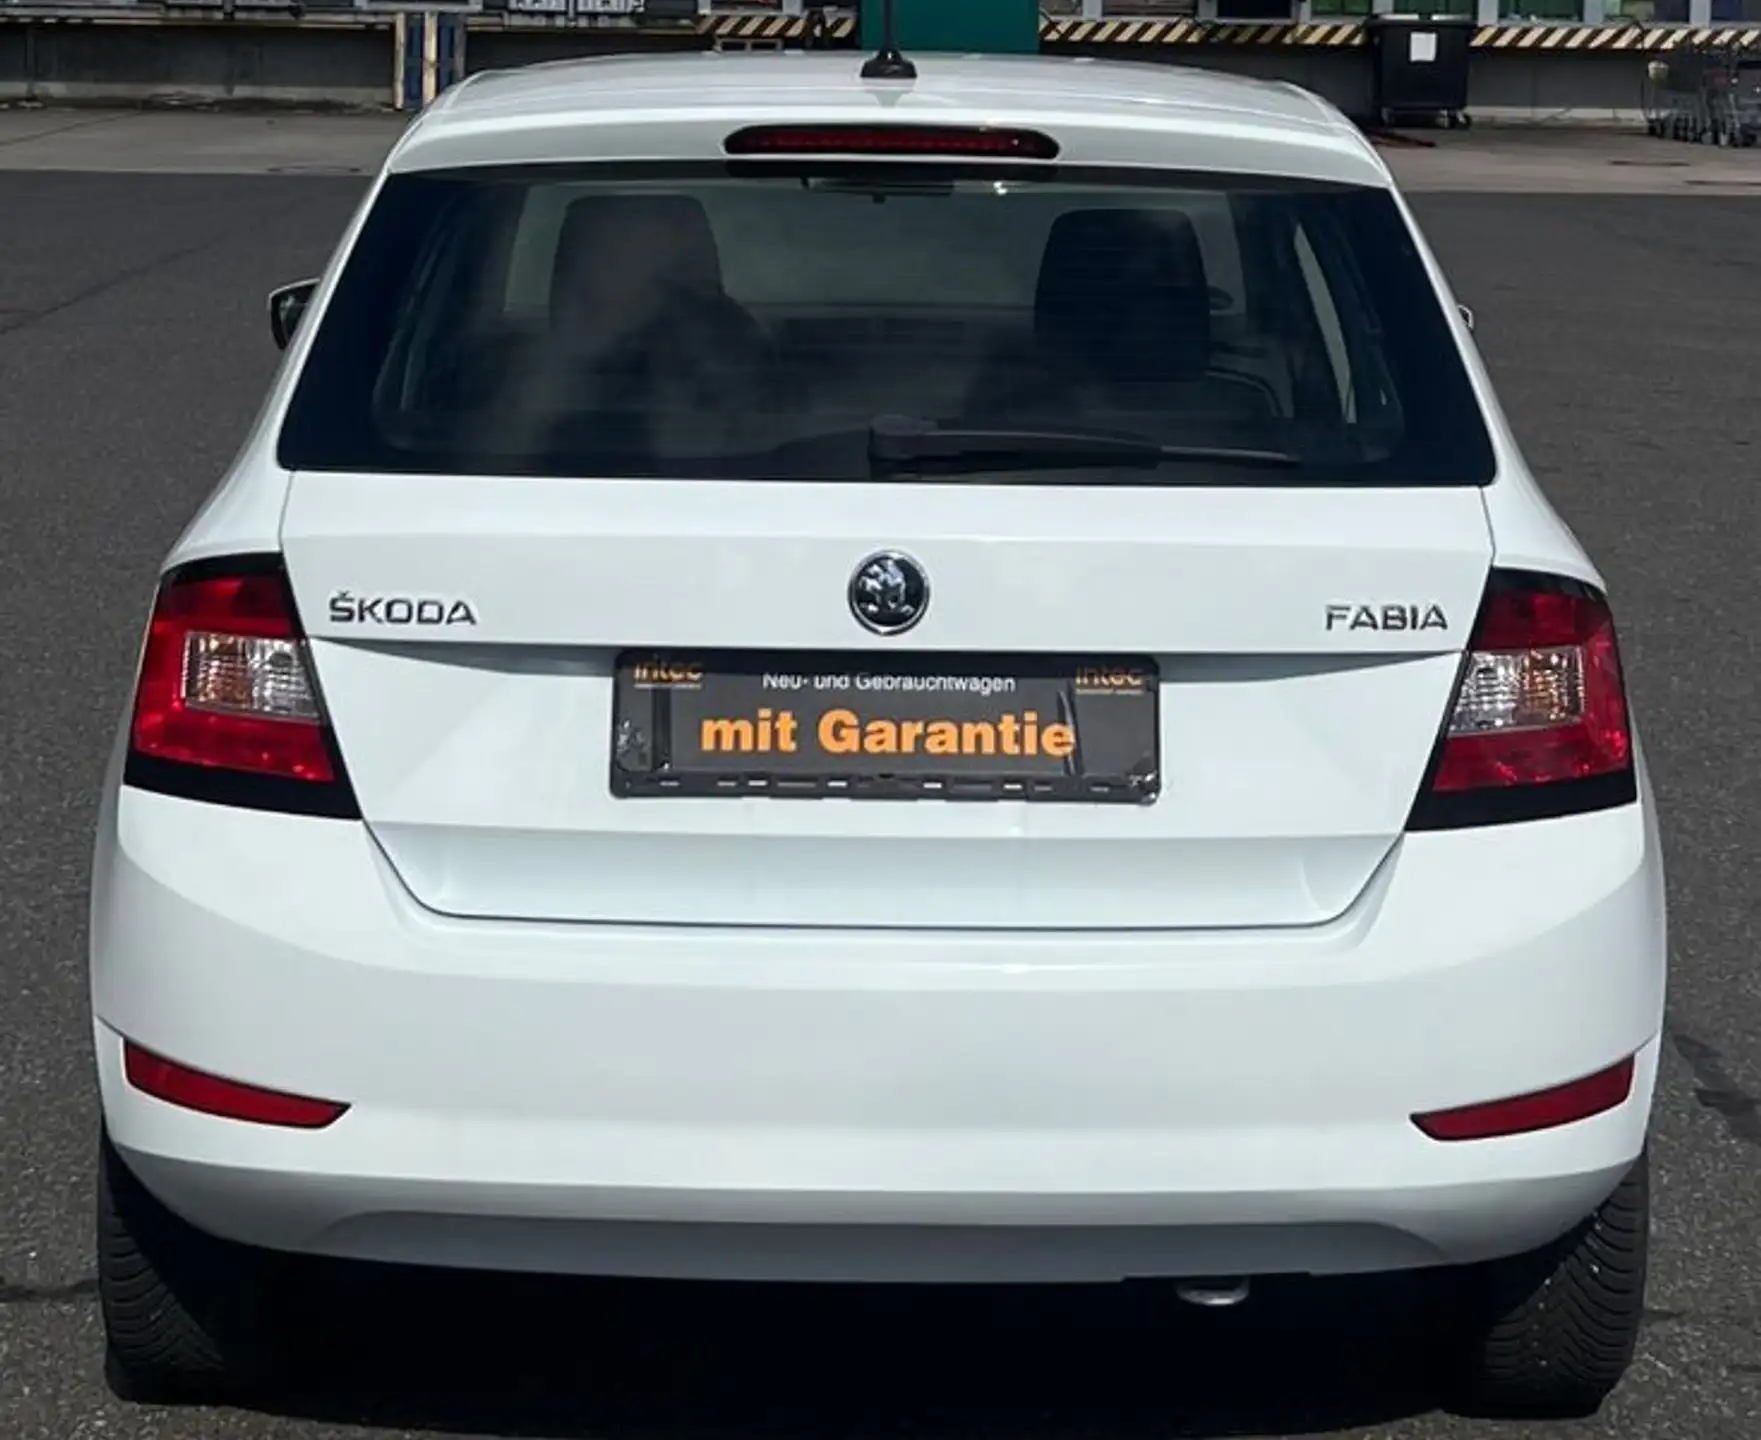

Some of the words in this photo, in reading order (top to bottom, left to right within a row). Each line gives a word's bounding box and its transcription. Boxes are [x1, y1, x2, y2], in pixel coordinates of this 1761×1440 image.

[329, 590, 477, 625] ŠKODA
[1325, 604, 1448, 630] FABIA
[762, 673, 808, 689] Neu-
[814, 674, 850, 689] und
[701, 709, 797, 752] mit
[817, 710, 1075, 756] Garantie
